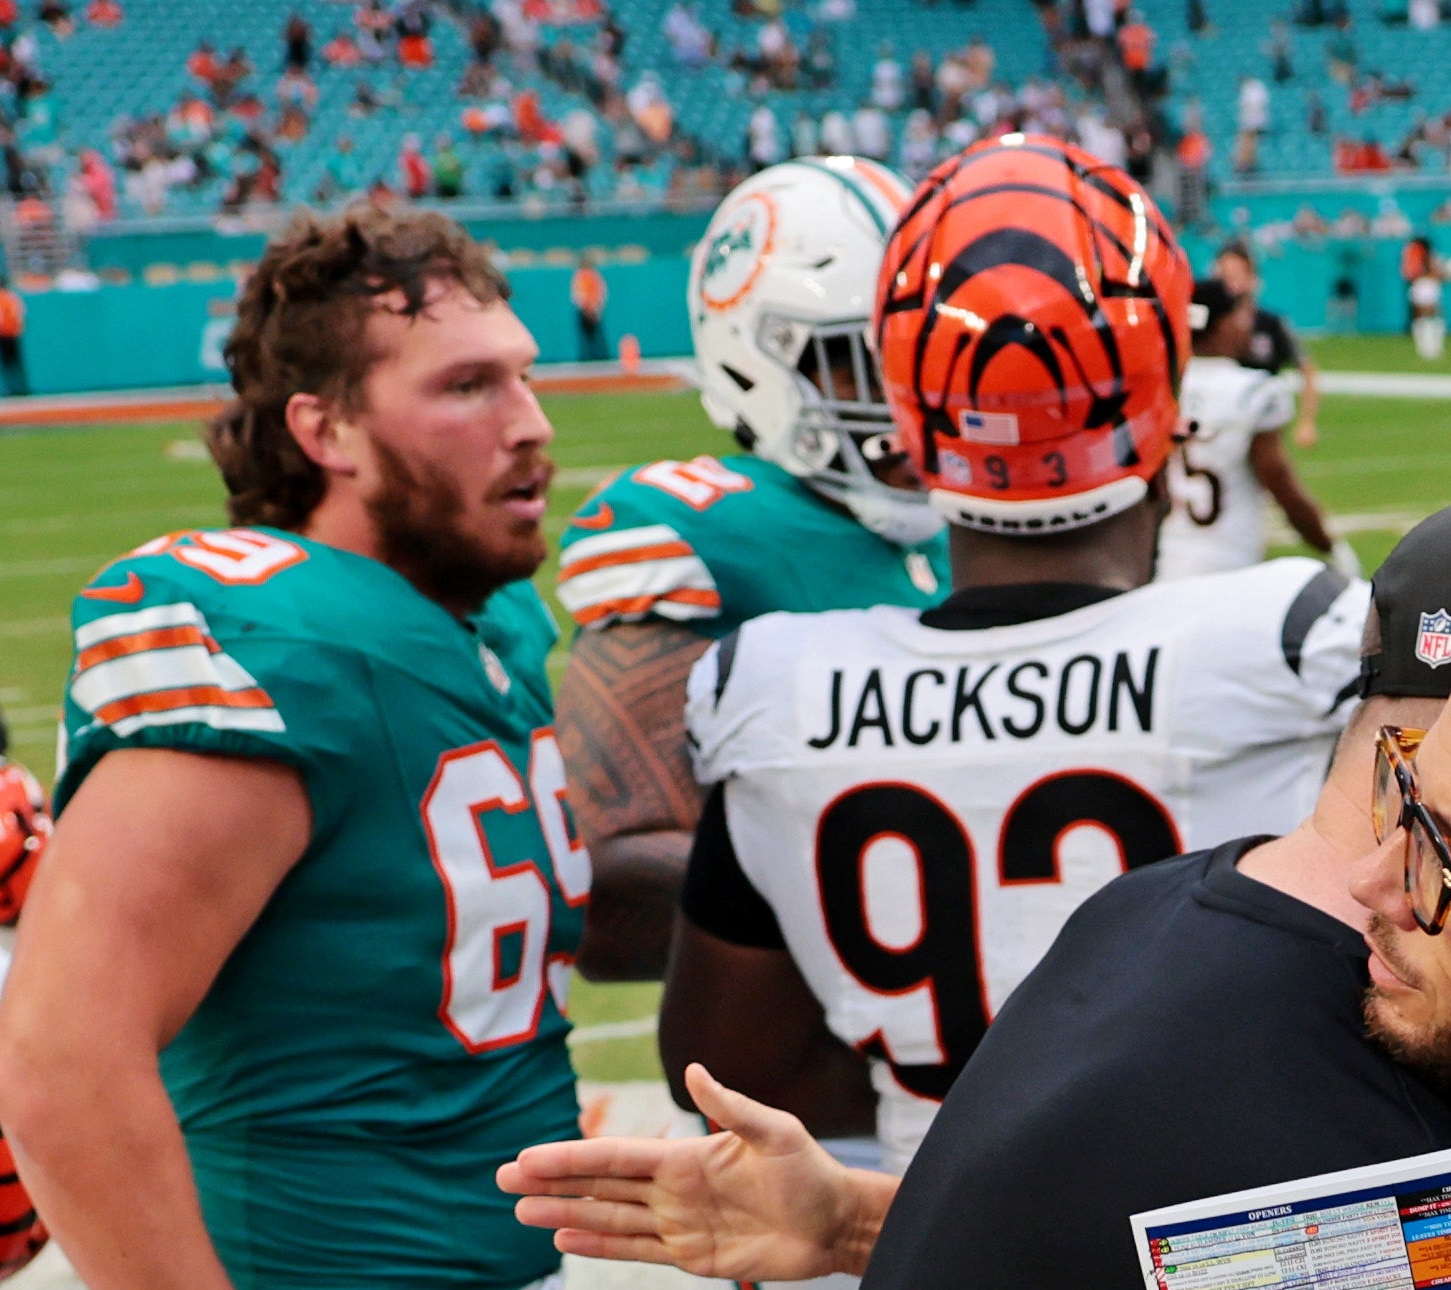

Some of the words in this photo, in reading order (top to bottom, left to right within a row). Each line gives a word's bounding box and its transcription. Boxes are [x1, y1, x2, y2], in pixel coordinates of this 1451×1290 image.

[1421, 634, 1451, 659] NFL
[807, 646, 1163, 751] JACKSON
[1248, 1205, 1292, 1220] OPENERS
